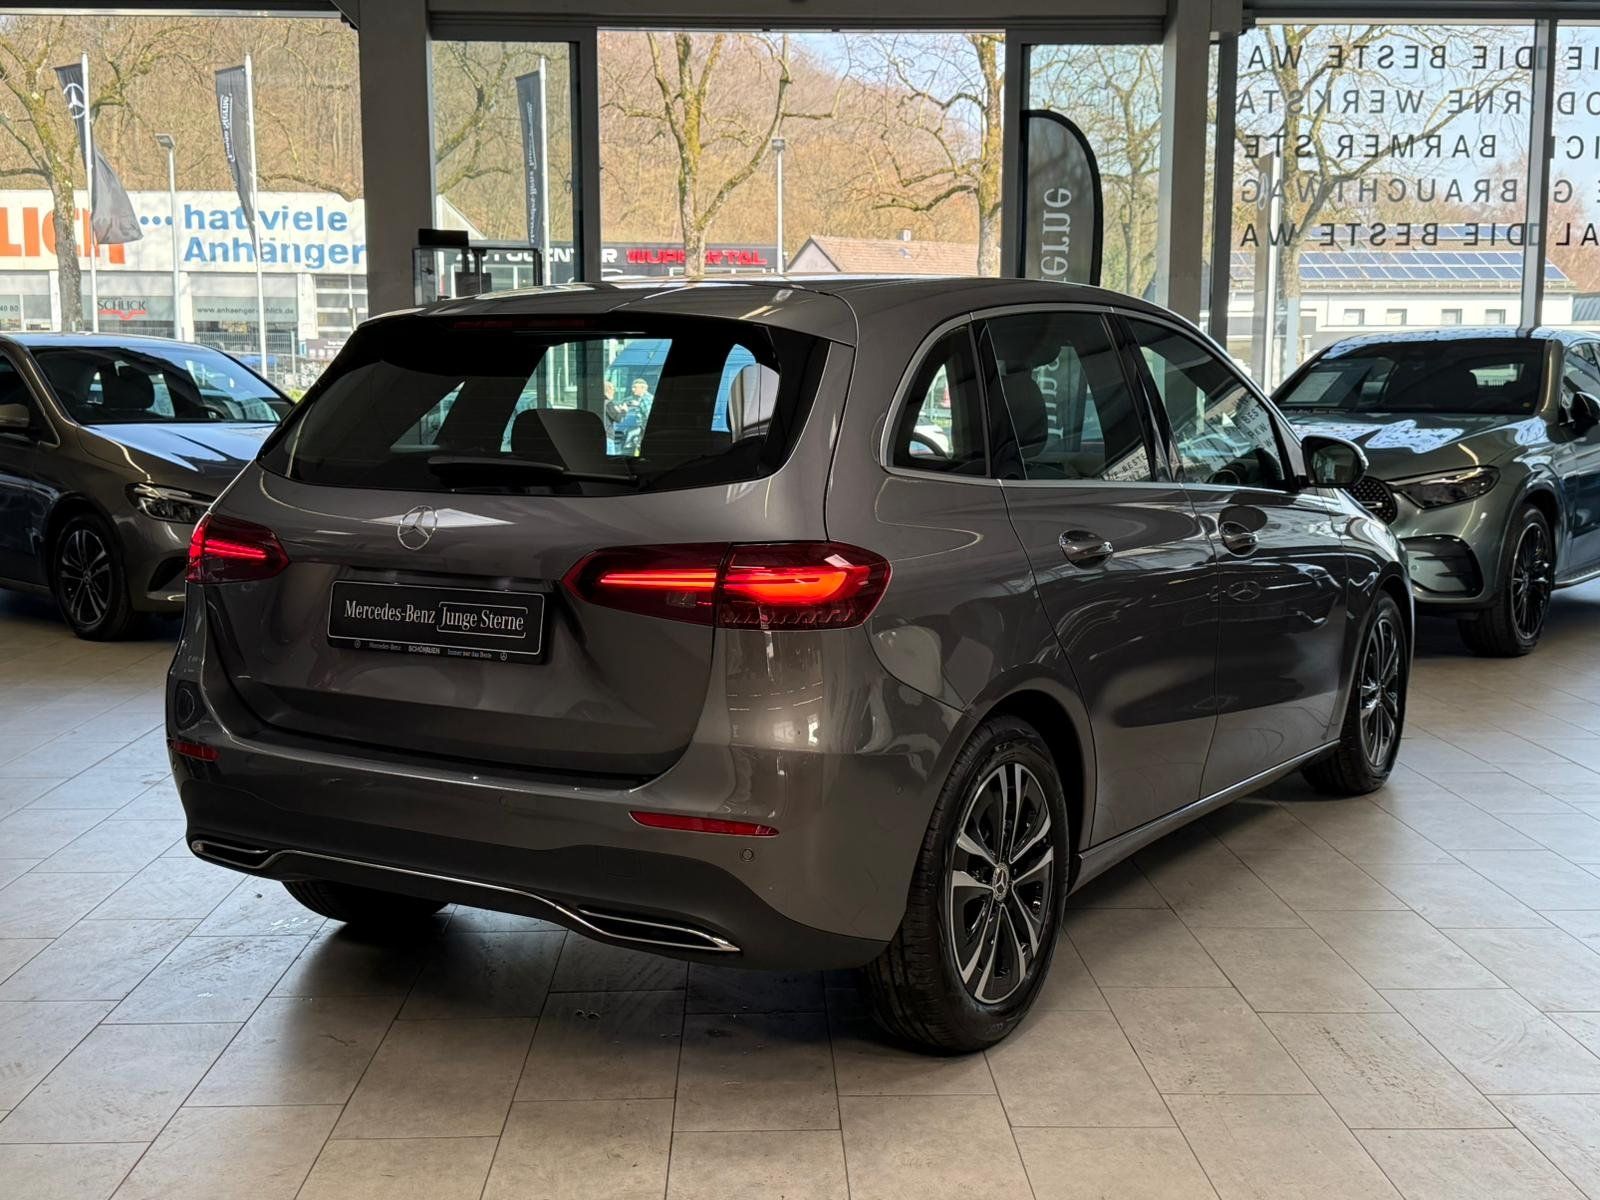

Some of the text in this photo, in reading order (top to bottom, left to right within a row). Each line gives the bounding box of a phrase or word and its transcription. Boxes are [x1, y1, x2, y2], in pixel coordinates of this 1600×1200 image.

[183, 204, 247, 230] hat
[258, 205, 348, 231] viele
[183, 236, 367, 269] Anhänger
[197, 306, 294, 315] www.anhaenger-hlick.de
[344, 600, 525, 631] Mercedes-Benz Junge Sterne
